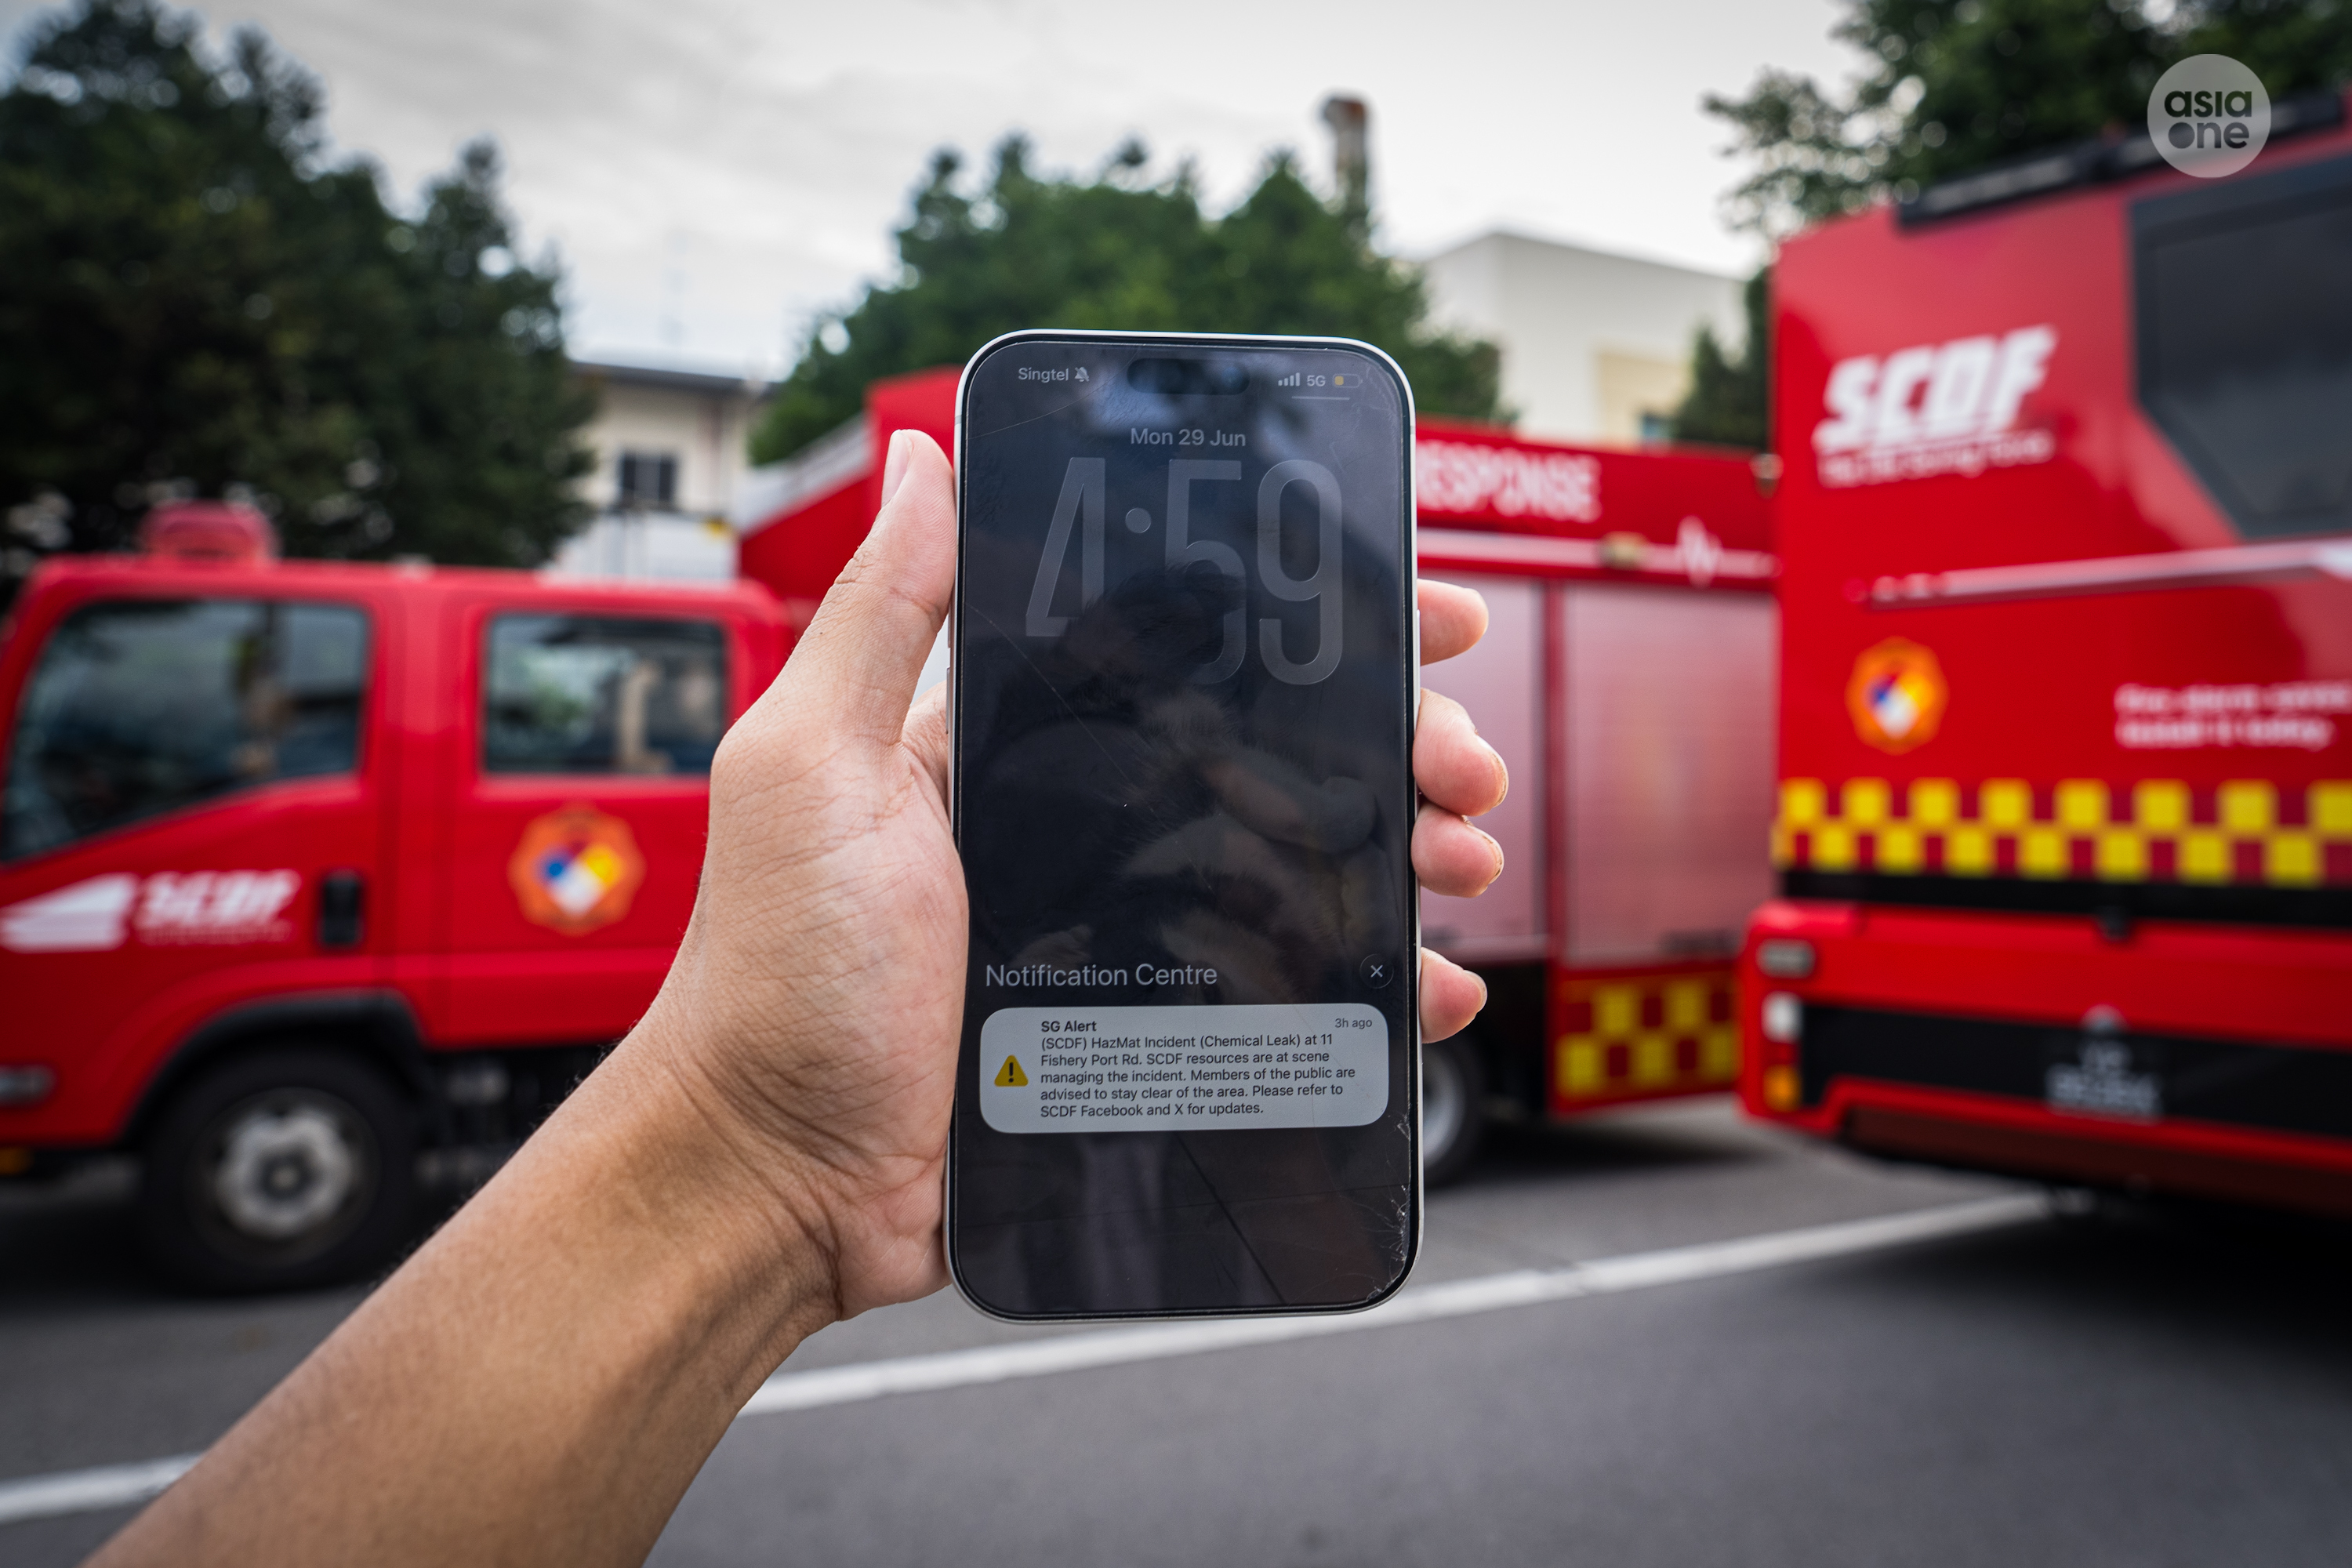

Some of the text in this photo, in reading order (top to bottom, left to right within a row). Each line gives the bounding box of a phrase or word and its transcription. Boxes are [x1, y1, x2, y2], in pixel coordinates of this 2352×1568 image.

[1018, 366, 1069, 384] Singtel
[1306, 375, 1327, 387] 5G
[1813, 321, 2057, 452] SCDF
[1130, 428, 1247, 447] Mon 29 Jun
[1416, 438, 1602, 523] ESPONSE
[1025, 457, 1344, 686] 4:59
[985, 963, 1218, 987] Notification Centre
[1041, 1020, 1097, 1033] SG Alert
[1335, 1018, 1373, 1029] 3h ago
[1042, 1033, 1333, 1051] (SCDF) HazMat Incident (Chemical Leak) at 11
[1041, 1051, 1330, 1068] Fishery Port Rd. SCDF resources are at scene
[1040, 1066, 1356, 1085] managing the incident. Members of the public are
[1040, 1083, 1343, 1102] advised to stay clear of the area. Please refer to
[1040, 1102, 1264, 1117] SCDF Facebook and X for updates.
